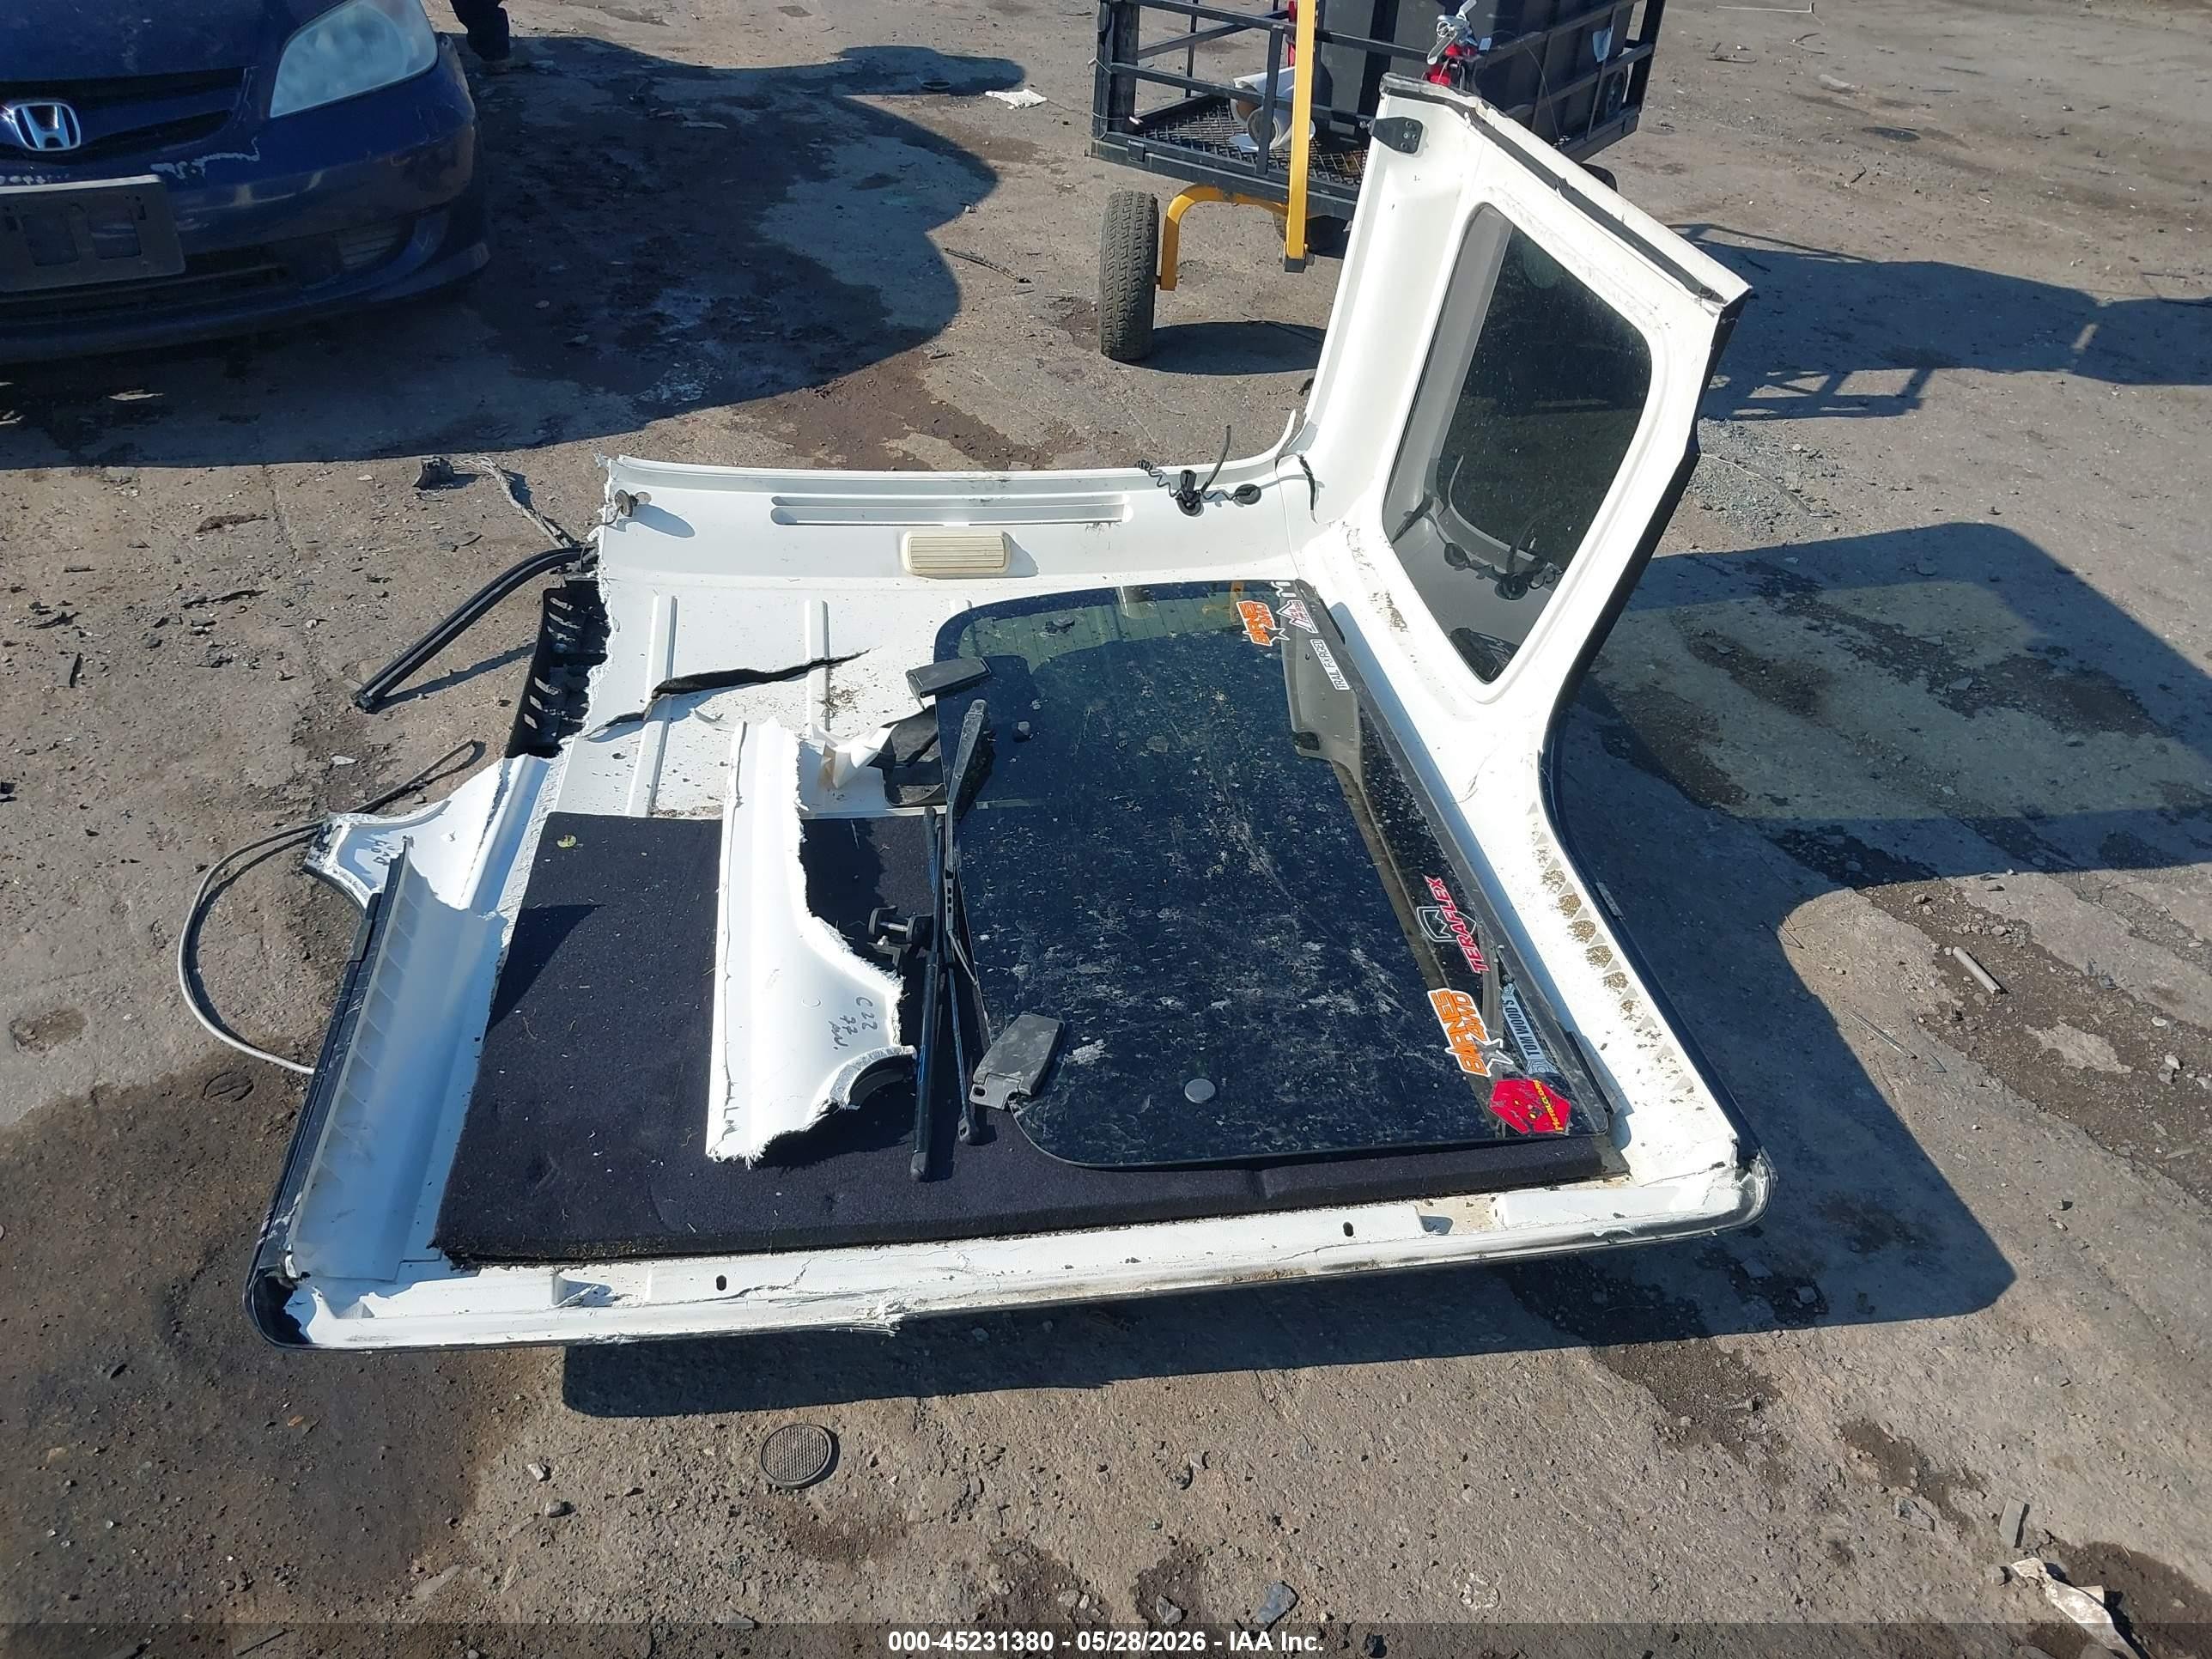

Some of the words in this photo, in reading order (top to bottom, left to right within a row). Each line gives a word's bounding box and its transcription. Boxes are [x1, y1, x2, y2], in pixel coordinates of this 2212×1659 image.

[1328, 669, 1350, 690] TRAIL
[1423, 874, 1490, 974] TERAFLEX
[1431, 990, 1488, 1074] BARNES
[1451, 993, 1488, 1042] 4WD
[1503, 1000, 1528, 1036] WOOD'S
[1521, 1034, 1540, 1057] TOM
